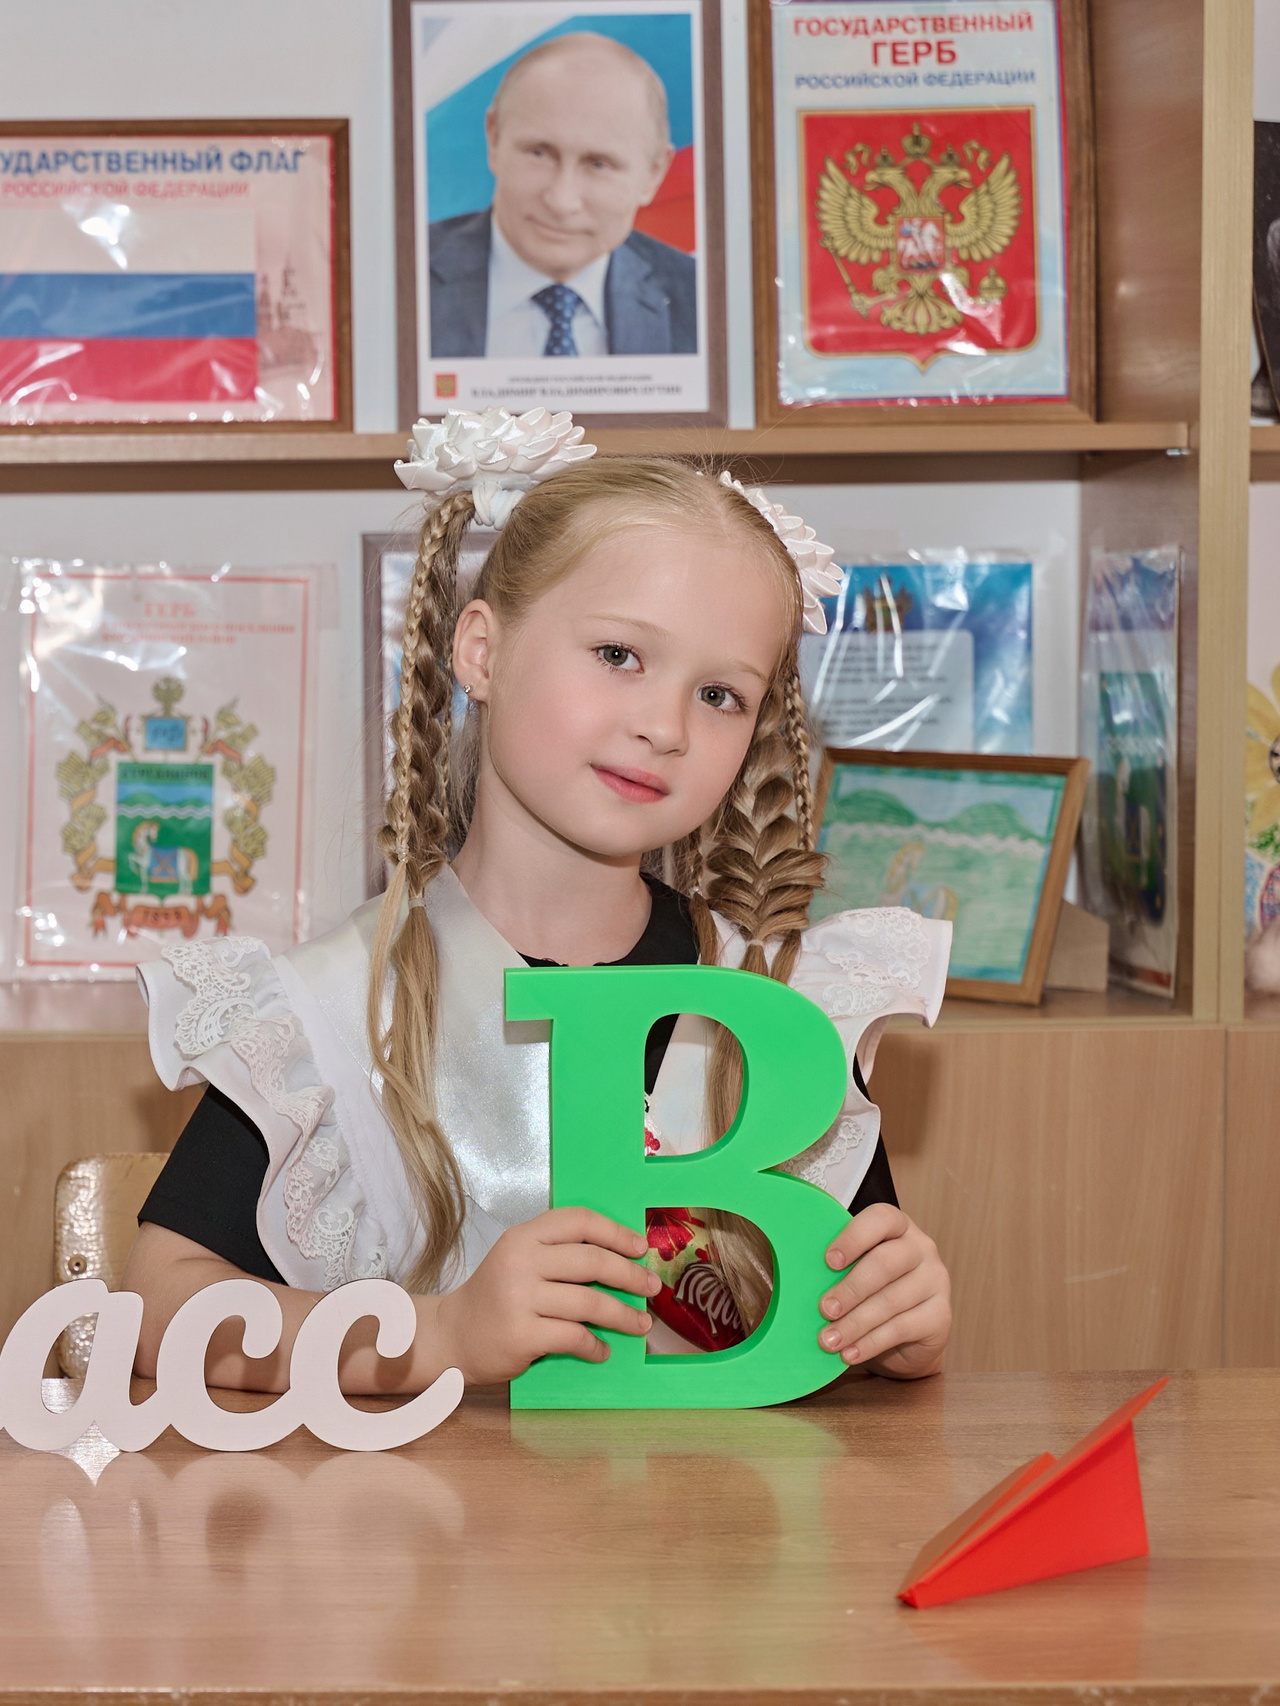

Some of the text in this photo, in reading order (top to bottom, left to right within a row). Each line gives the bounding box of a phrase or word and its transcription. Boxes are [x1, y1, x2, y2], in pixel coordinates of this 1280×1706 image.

[793, 11, 1034, 37] ГОСУДАРСТВЕННЫЙ
[872, 40, 958, 67] ГЕРБ
[795, 69, 1036, 89] РОССИЙСКОЙ ФЕДЕРАЦИИ
[229, 148, 305, 174] ФЛАГ
[1, 178, 250, 199] РОССИЙСКОЙ ФЕДЕРАЦИИ
[504, 964, 857, 1410] В
